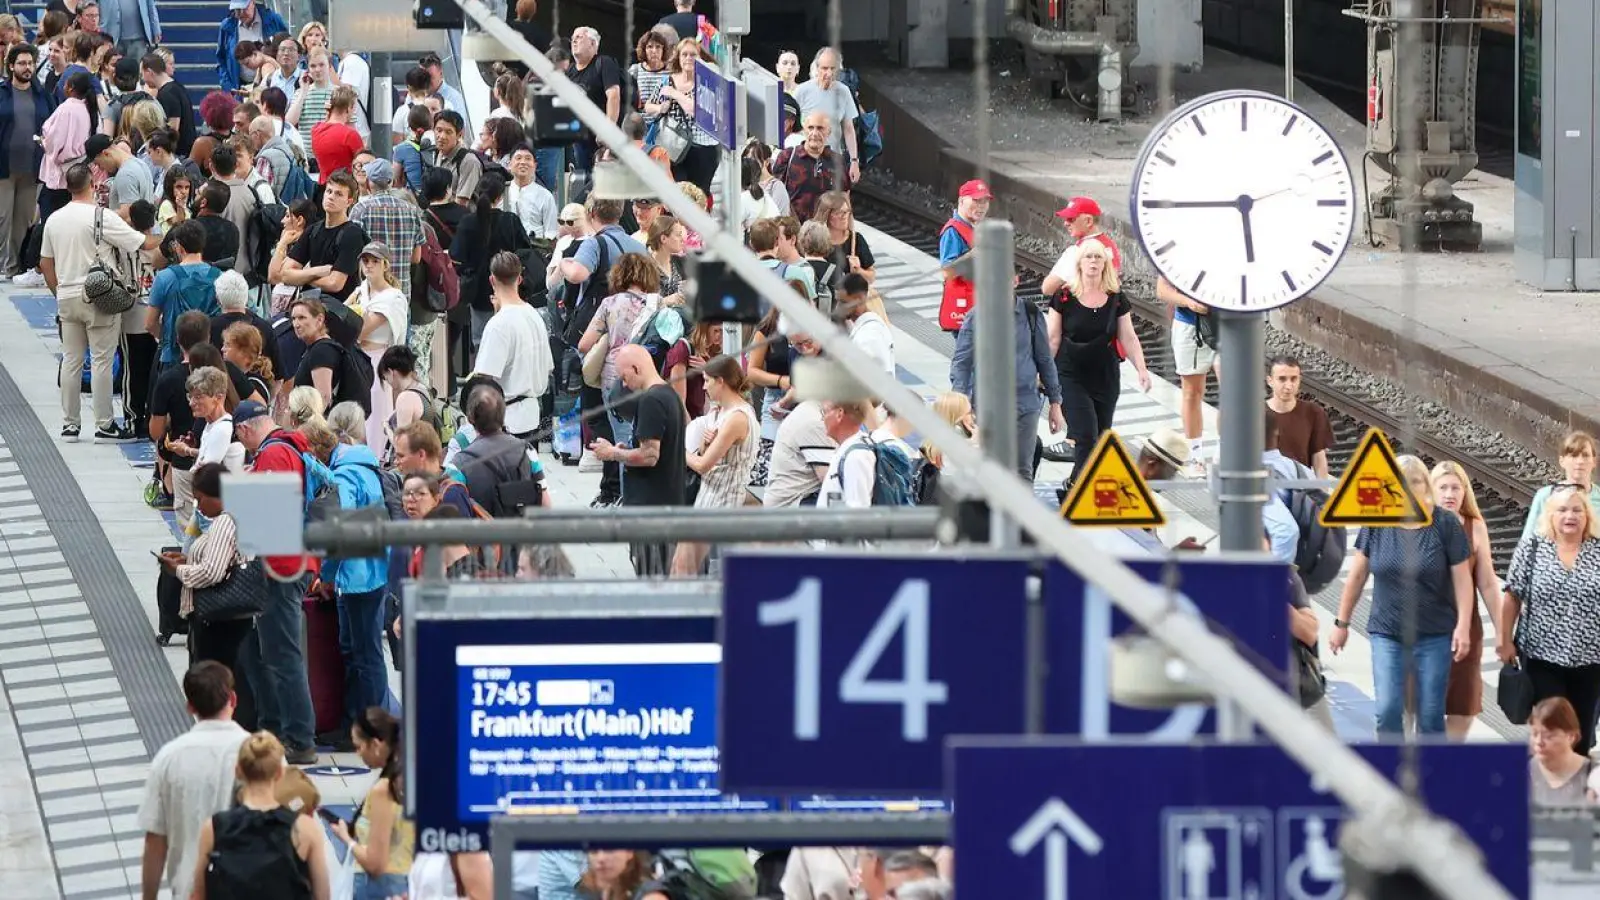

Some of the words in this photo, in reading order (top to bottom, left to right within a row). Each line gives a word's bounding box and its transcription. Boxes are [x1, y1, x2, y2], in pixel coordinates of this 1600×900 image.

[757, 576, 949, 742] 14
[472, 681, 532, 706] 17:45
[471, 706, 694, 741] Frankfurt(Main)Hbf
[421, 827, 482, 852] Gleis
